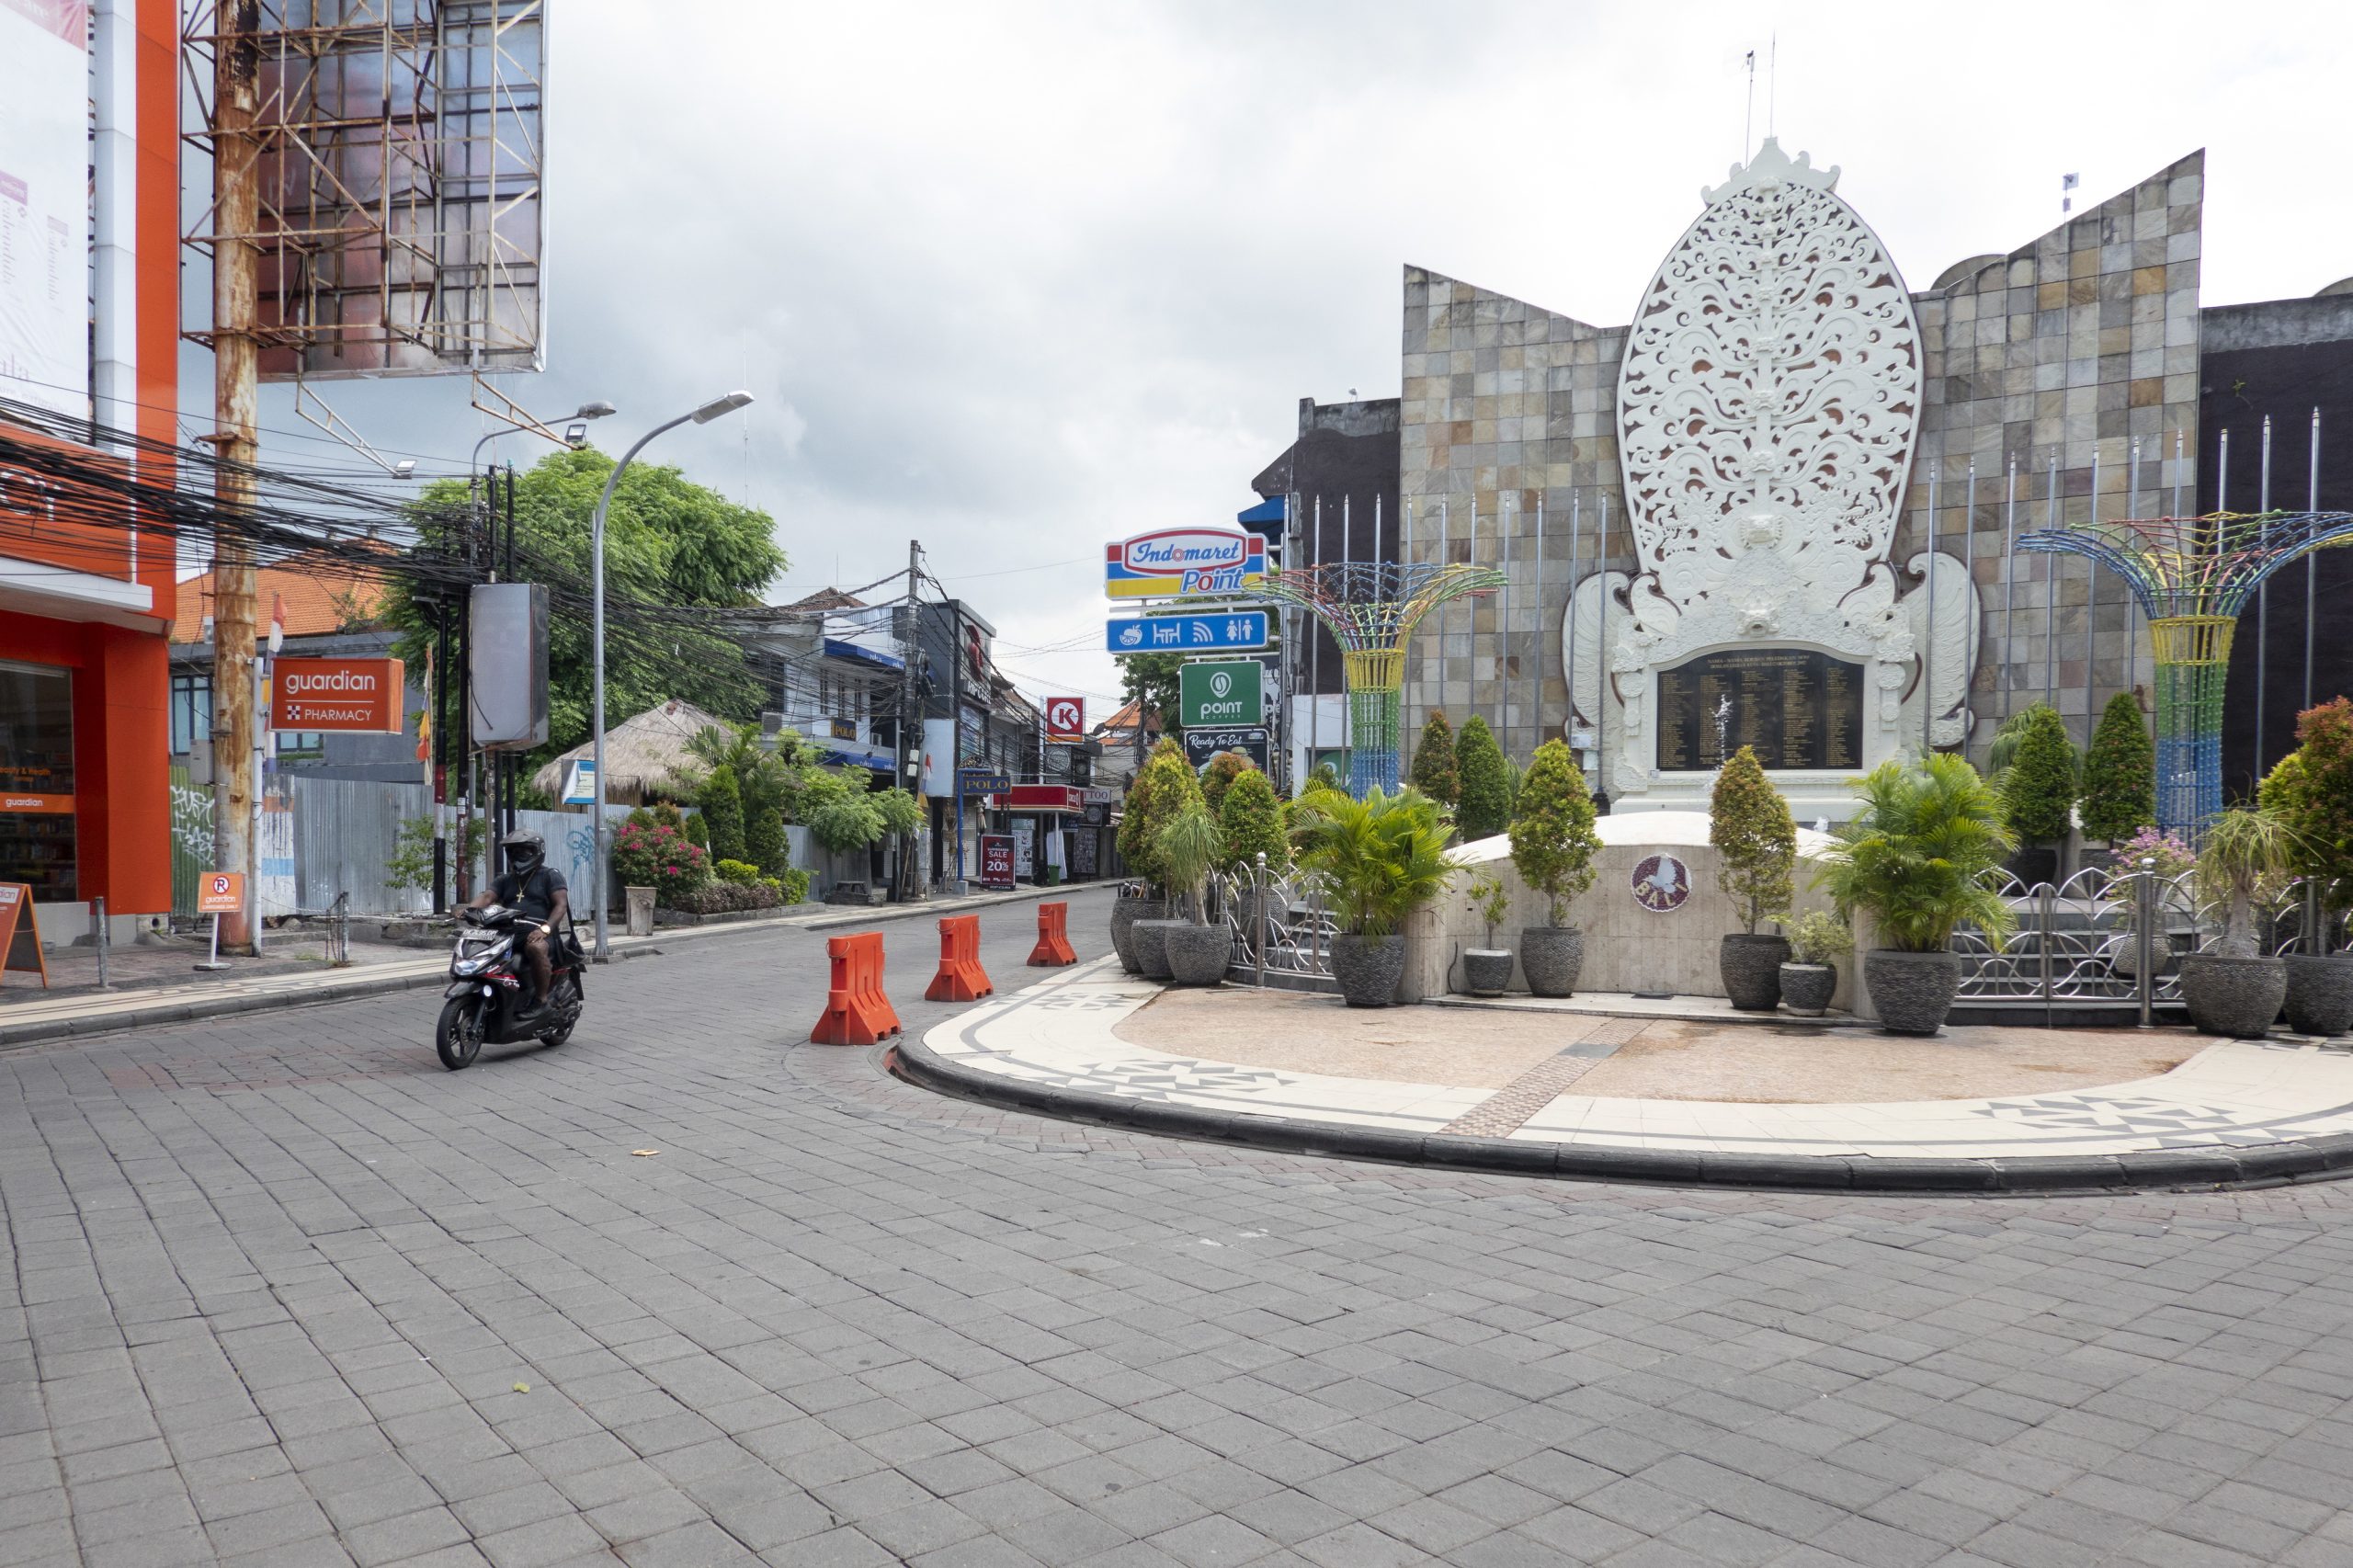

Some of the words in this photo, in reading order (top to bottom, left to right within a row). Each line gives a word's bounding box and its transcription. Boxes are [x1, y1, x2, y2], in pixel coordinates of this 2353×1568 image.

[1132, 541, 1240, 563] Indomaret
[1182, 568, 1245, 593] Point
[286, 670, 376, 695] guardian
[304, 709, 372, 722] PHARMACY
[1189, 734, 1215, 749] Ready
[1215, 733, 1227, 746] To
[1227, 734, 1243, 746] Eat
[965, 779, 1009, 789] POLO
[6, 798, 43, 807] guardian
